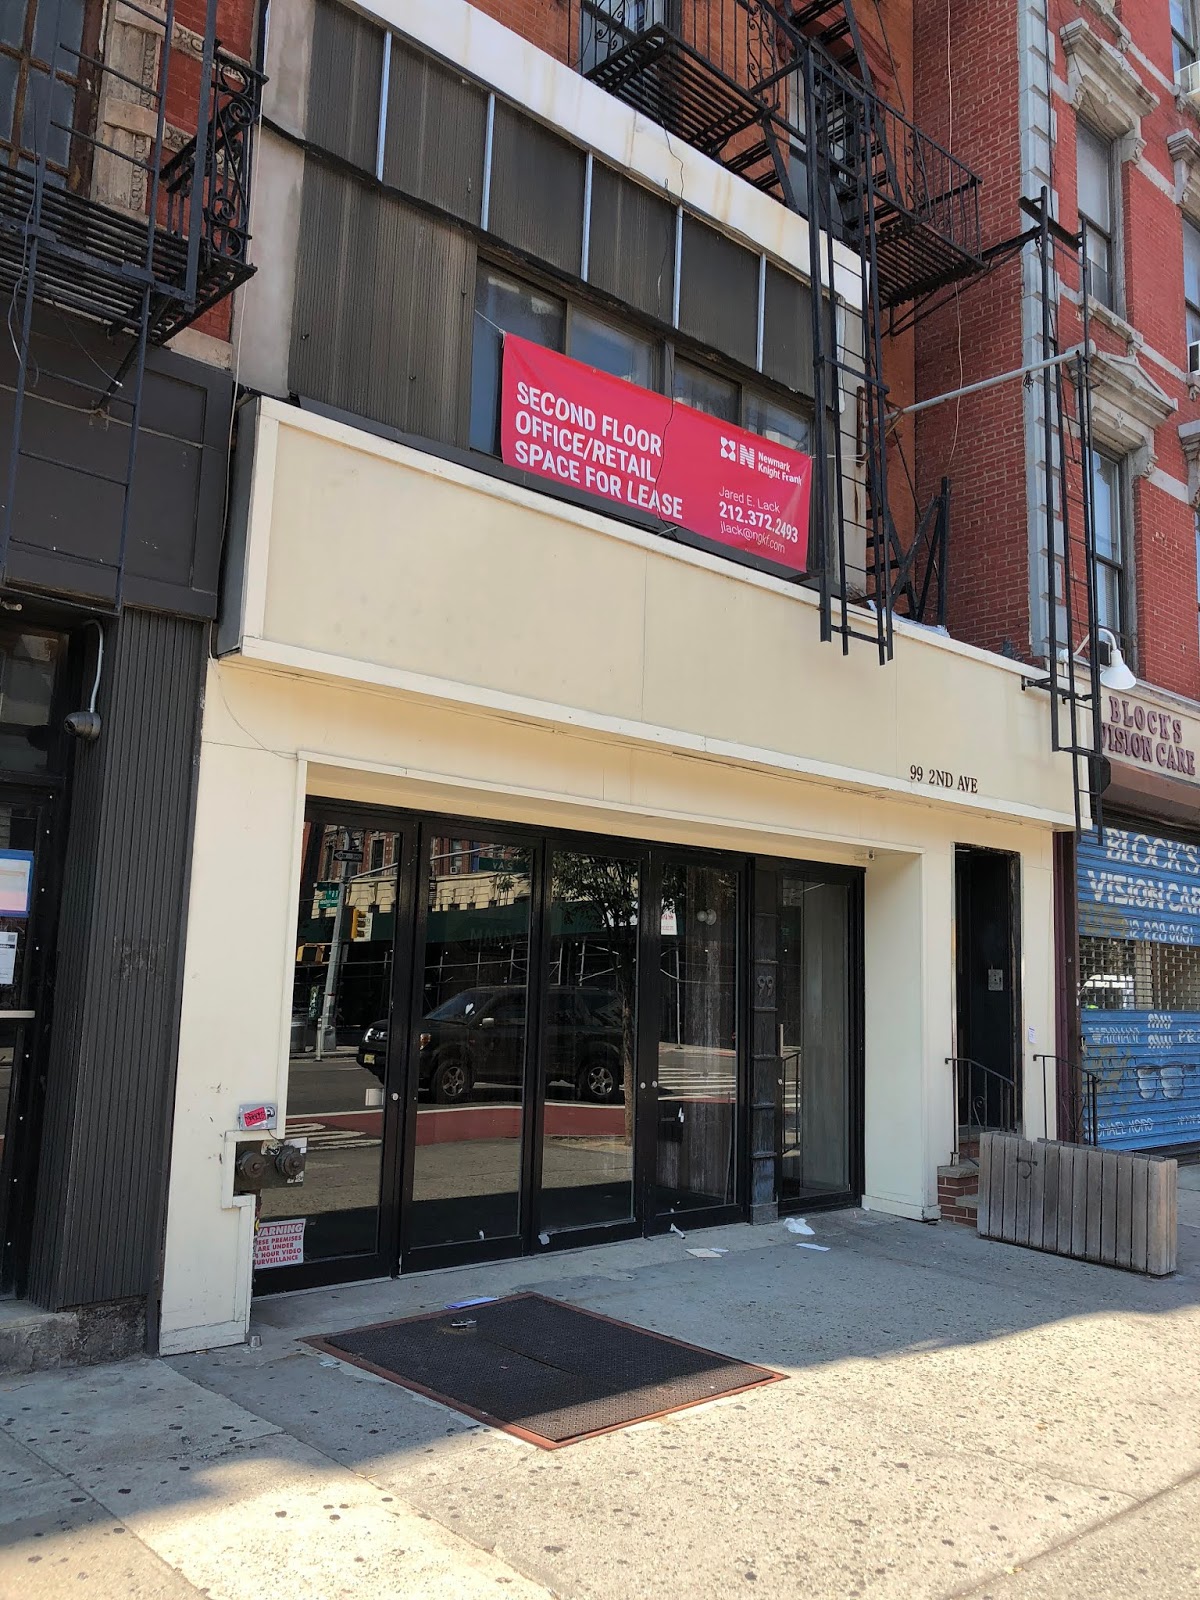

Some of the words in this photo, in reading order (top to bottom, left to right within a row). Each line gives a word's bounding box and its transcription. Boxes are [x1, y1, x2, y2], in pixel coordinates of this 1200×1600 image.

[517, 381, 596, 432] SECOND
[601, 415, 662, 458] FLOOR
[515, 410, 656, 483] OFFICE/RETAIL
[758, 451, 791, 473] Newmark
[515, 440, 580, 484] SPACE
[585, 467, 622, 499] FOR
[627, 483, 683, 519] LEASE
[758, 462, 781, 479] Knight
[719, 486, 745, 504] Jared
[746, 495, 755, 507] E.
[757, 498, 780, 513] Lack
[719, 501, 798, 543] 212.372.2493
[720, 520, 785, 554] jlack@ngkf.com
[1109, 695, 1183, 743] BLOCK'S
[1102, 722, 1153, 763] VISION
[1156, 742, 1196, 776] CARE
[910, 764, 924, 782] 99
[928, 769, 954, 788] 2ND
[957, 775, 978, 794] AVE
[1087, 870, 1165, 910] VISION
[756, 975, 774, 997] 99
[261, 1250, 280, 1258] HOUR
[282, 1247, 302, 1255] VIDEO
[271, 1235, 302, 1244] PREMISES
[272, 1242, 294, 1250] UNDER
